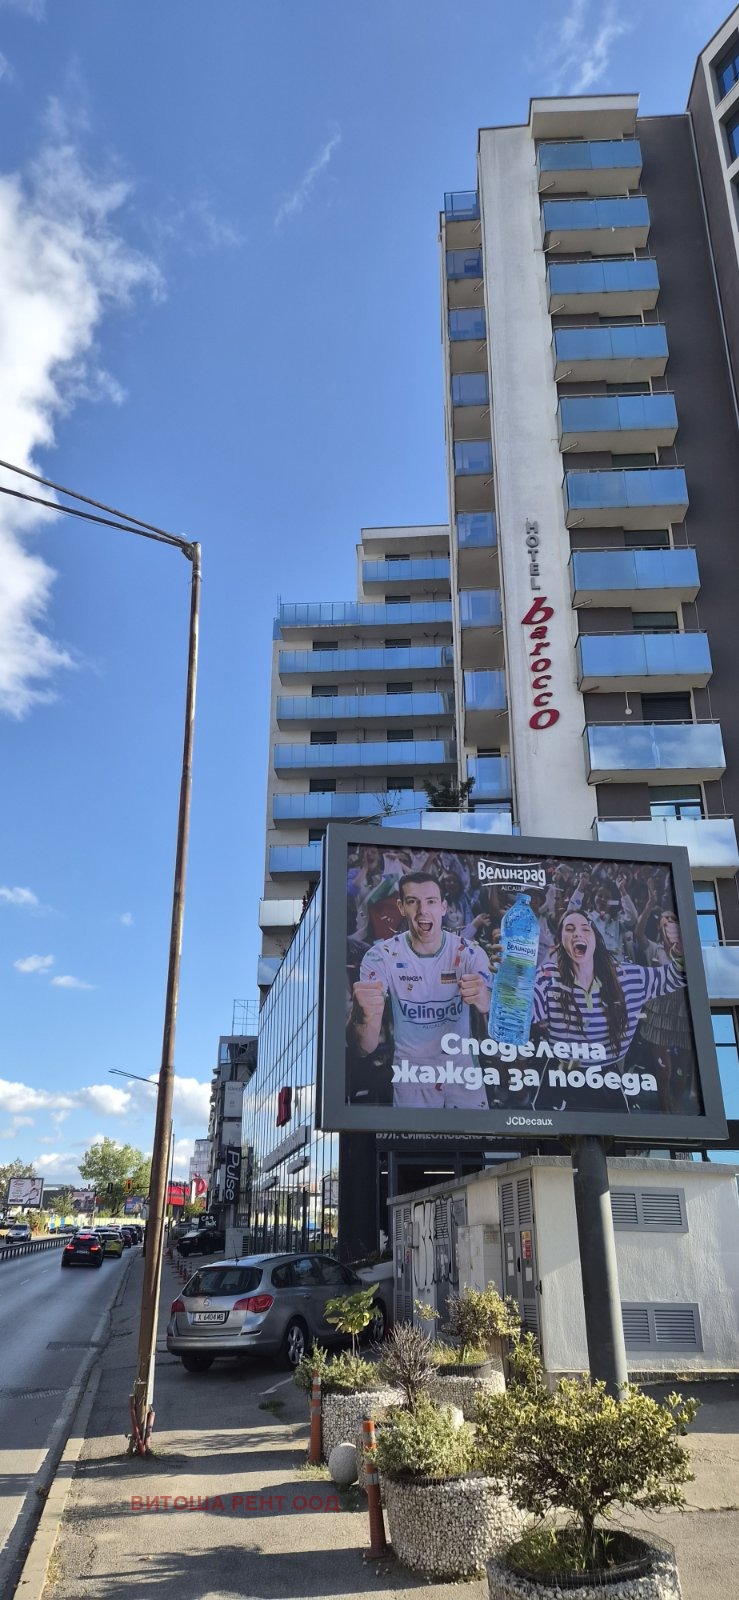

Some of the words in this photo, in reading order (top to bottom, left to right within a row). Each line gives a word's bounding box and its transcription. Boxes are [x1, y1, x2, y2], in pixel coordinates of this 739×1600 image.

[525, 520, 541, 591] HOTEL
[521, 597, 560, 730] barocco
[477, 861, 547, 887] Велинград
[441, 1033, 607, 1062] Споделена
[391, 1060, 500, 1091] жажда
[508, 1067, 540, 1092] за
[549, 1066, 658, 1096] победа
[506, 1116, 553, 1126] JCDecaux
[225, 1150, 240, 1201] Pulse
